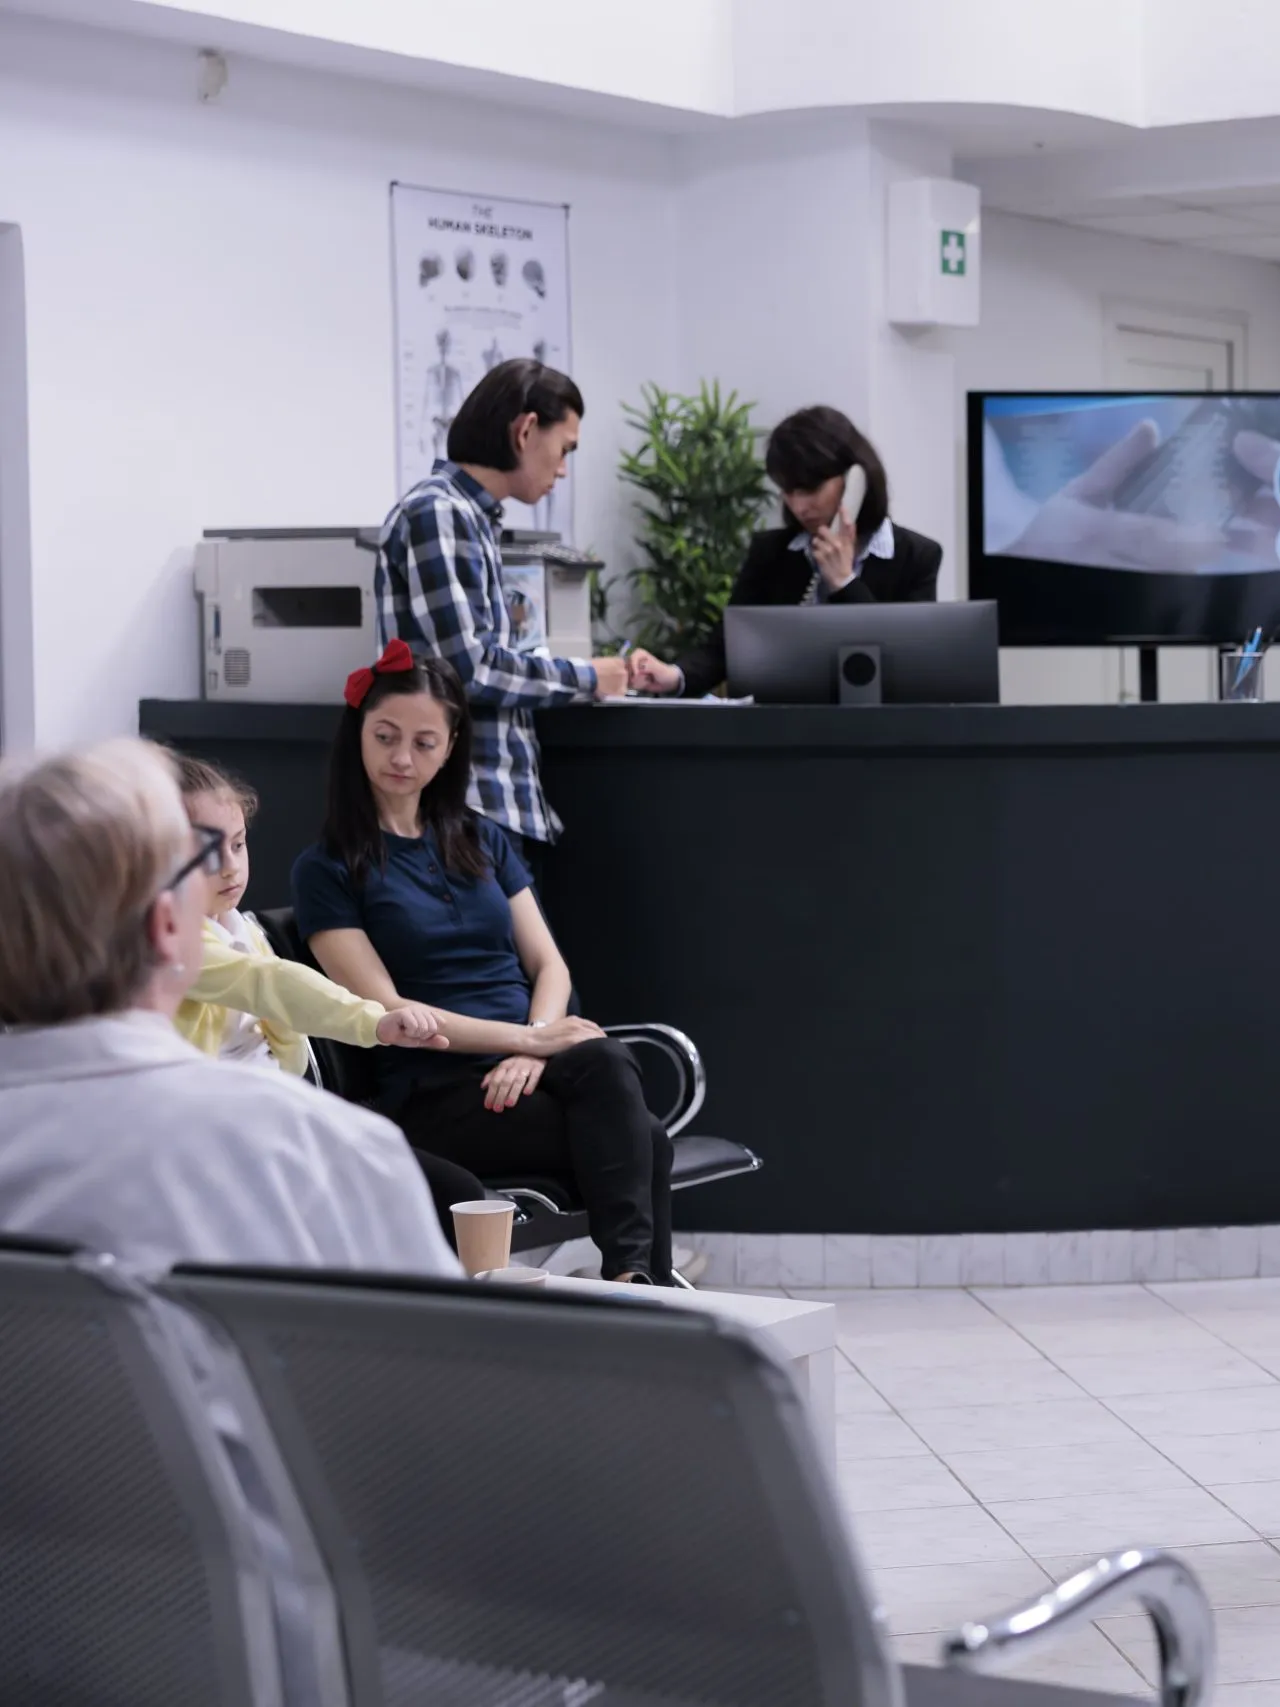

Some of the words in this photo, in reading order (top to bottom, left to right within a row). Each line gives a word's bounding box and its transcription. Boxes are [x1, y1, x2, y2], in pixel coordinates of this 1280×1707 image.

[472, 204, 493, 219] THE
[428, 217, 471, 233] HUMAN
[475, 222, 533, 240] SKELETON
